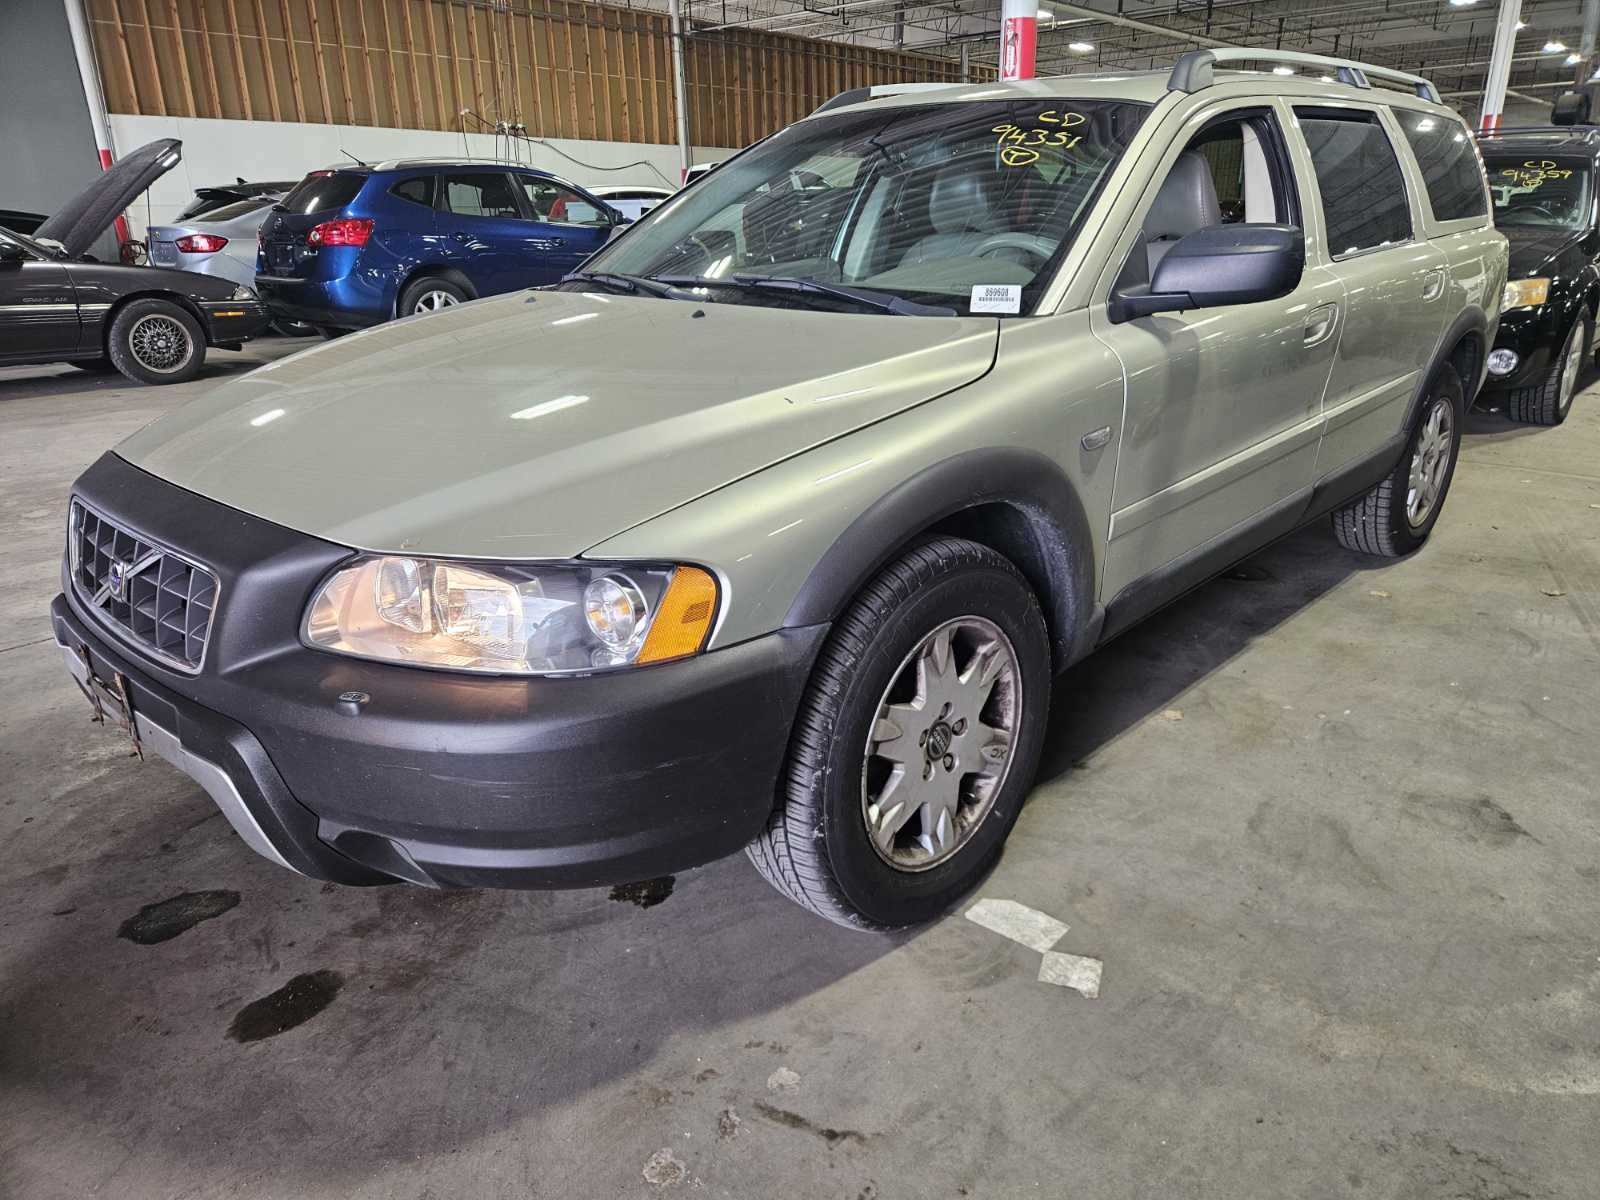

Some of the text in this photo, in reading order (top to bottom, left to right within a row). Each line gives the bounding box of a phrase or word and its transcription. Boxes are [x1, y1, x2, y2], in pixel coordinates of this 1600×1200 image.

[1038, 111, 1086, 127] CD
[992, 124, 1084, 149] 94351
[1523, 160, 1557, 169] CD
